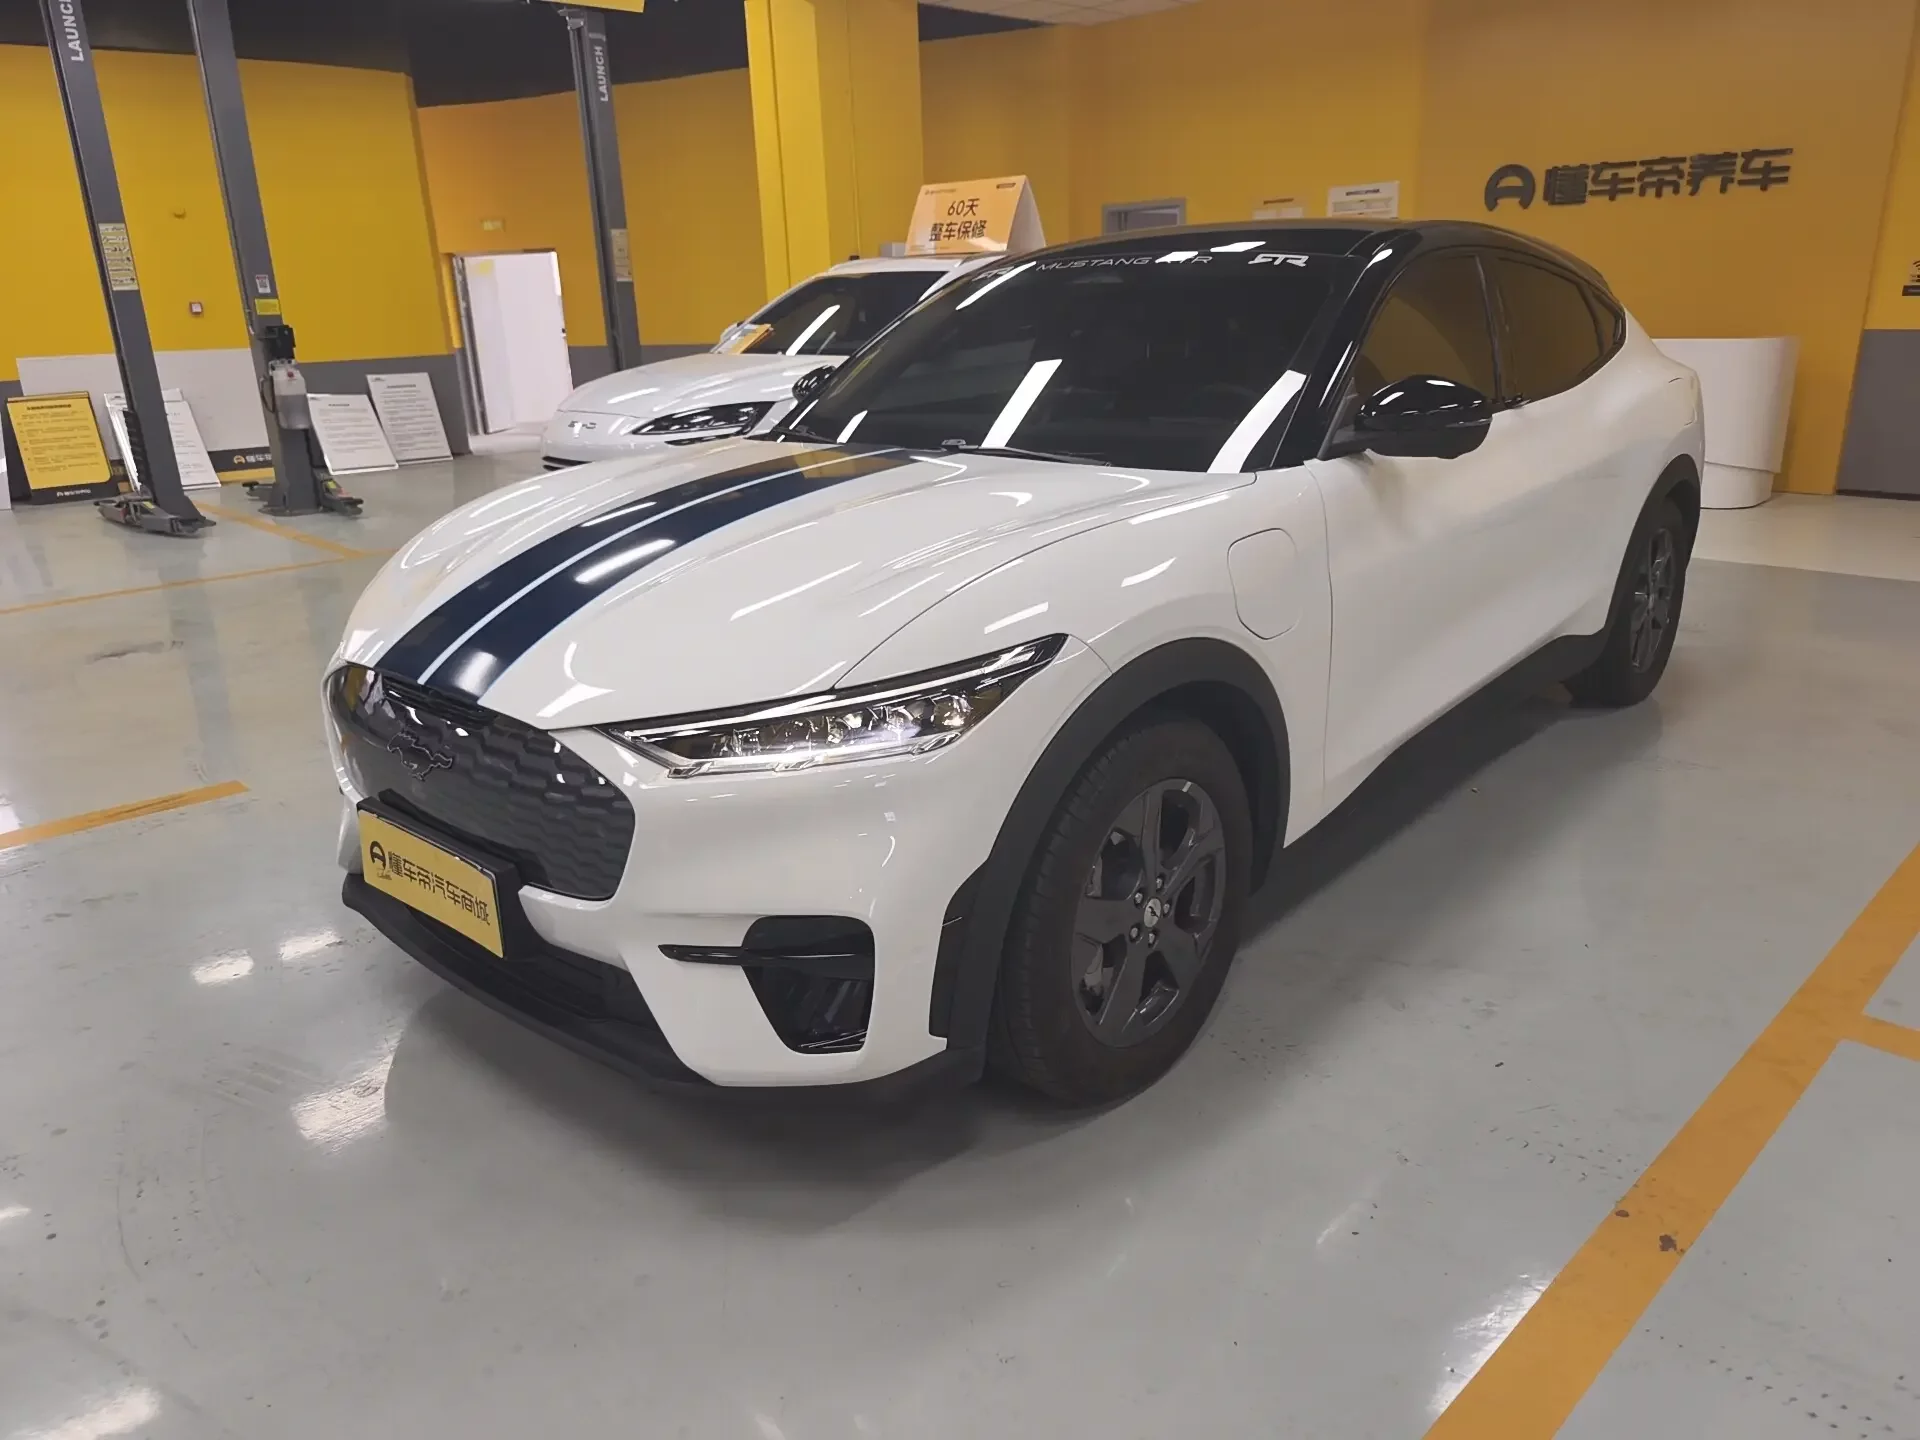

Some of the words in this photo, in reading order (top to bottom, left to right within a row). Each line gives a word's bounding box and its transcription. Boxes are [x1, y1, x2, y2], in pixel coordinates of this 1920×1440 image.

[59, 0, 85, 62] LAUNC
[593, 45, 609, 102] LAUNCH
[1542, 147, 1794, 206] 懂车帝养车
[928, 219, 988, 242] 整车保修
[946, 197, 980, 217] 60天
[1036, 256, 1153, 271] MUSTANG
[387, 850, 492, 926] 懂车帝汽车商城
